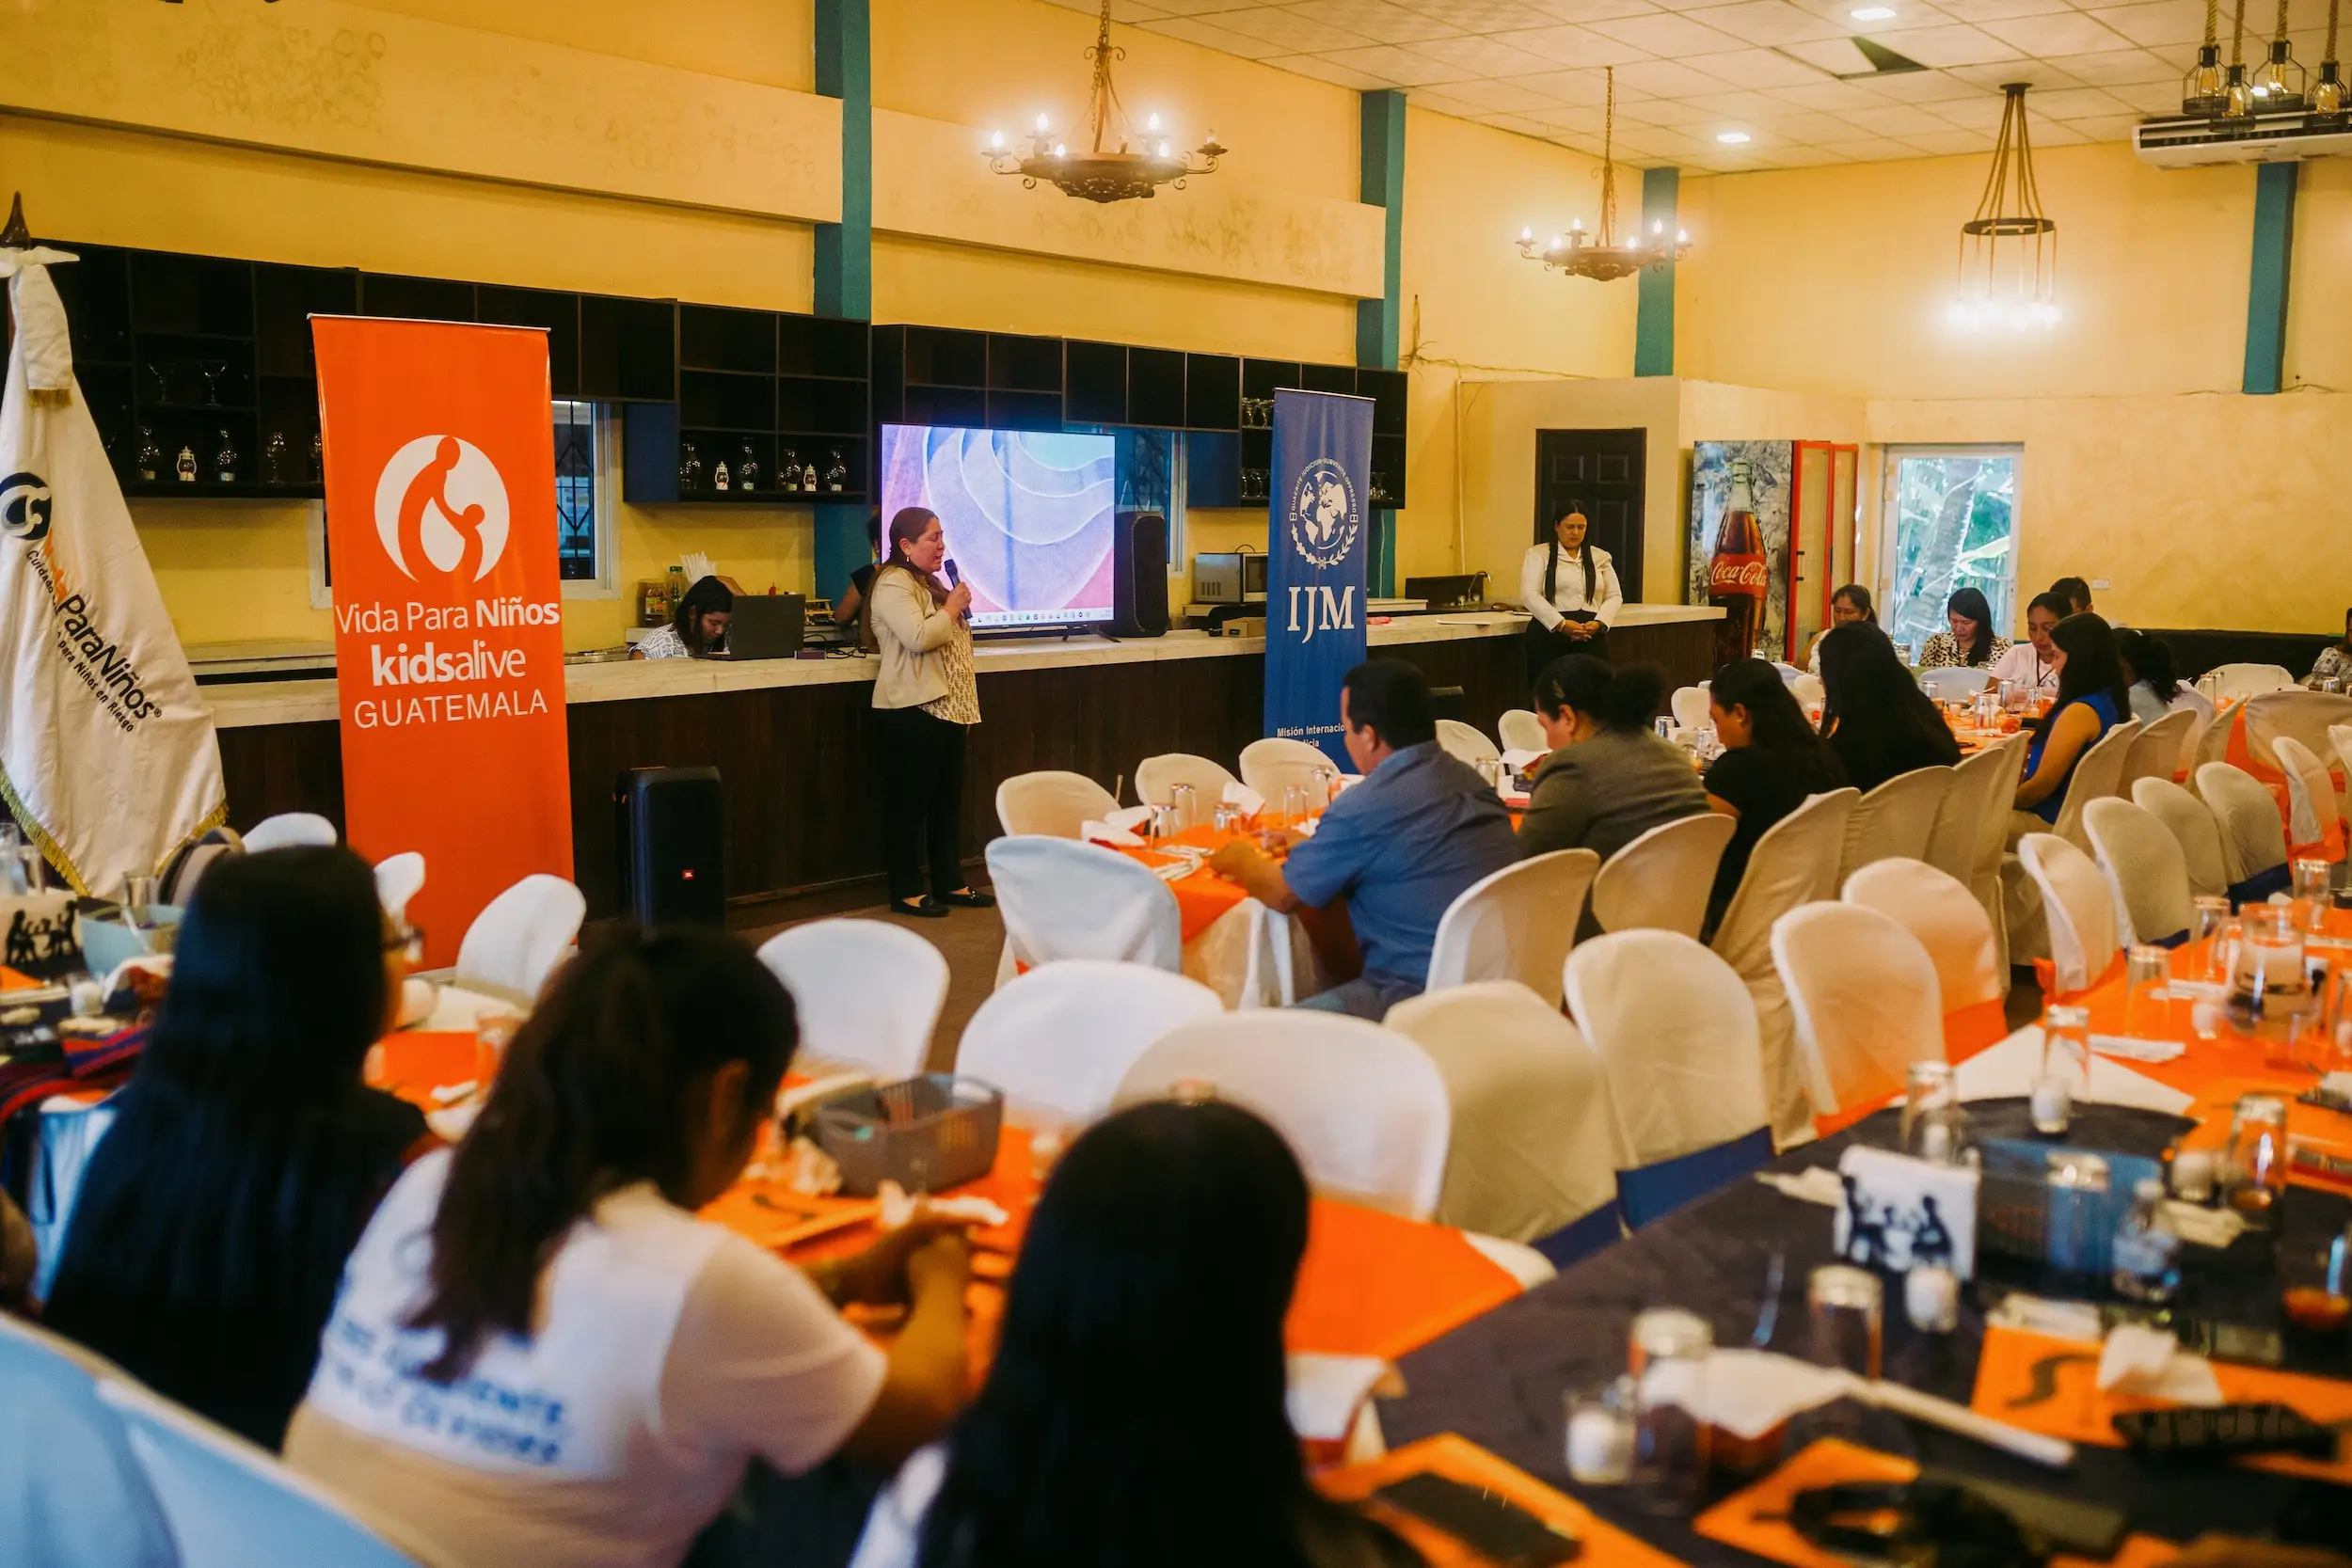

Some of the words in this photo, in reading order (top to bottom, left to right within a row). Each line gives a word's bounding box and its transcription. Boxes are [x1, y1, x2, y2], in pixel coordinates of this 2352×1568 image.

[26, 549, 54, 594] Cuidado
[1710, 561, 1768, 587] Coca-Cola
[335, 601, 399, 634] Vida
[406, 601, 469, 631] Para
[475, 596, 561, 628] Niños
[1287, 585, 1355, 644] IJM
[371, 639, 526, 687] kidsalive
[58, 641, 75, 663] para
[73, 663, 97, 691] Niños
[96, 689, 108, 704] en
[107, 702, 134, 732] Riesgo
[354, 689, 548, 729] GUATEMALA
[1277, 726, 1304, 738] Misión
[1306, 722, 1347, 736] Internacio
